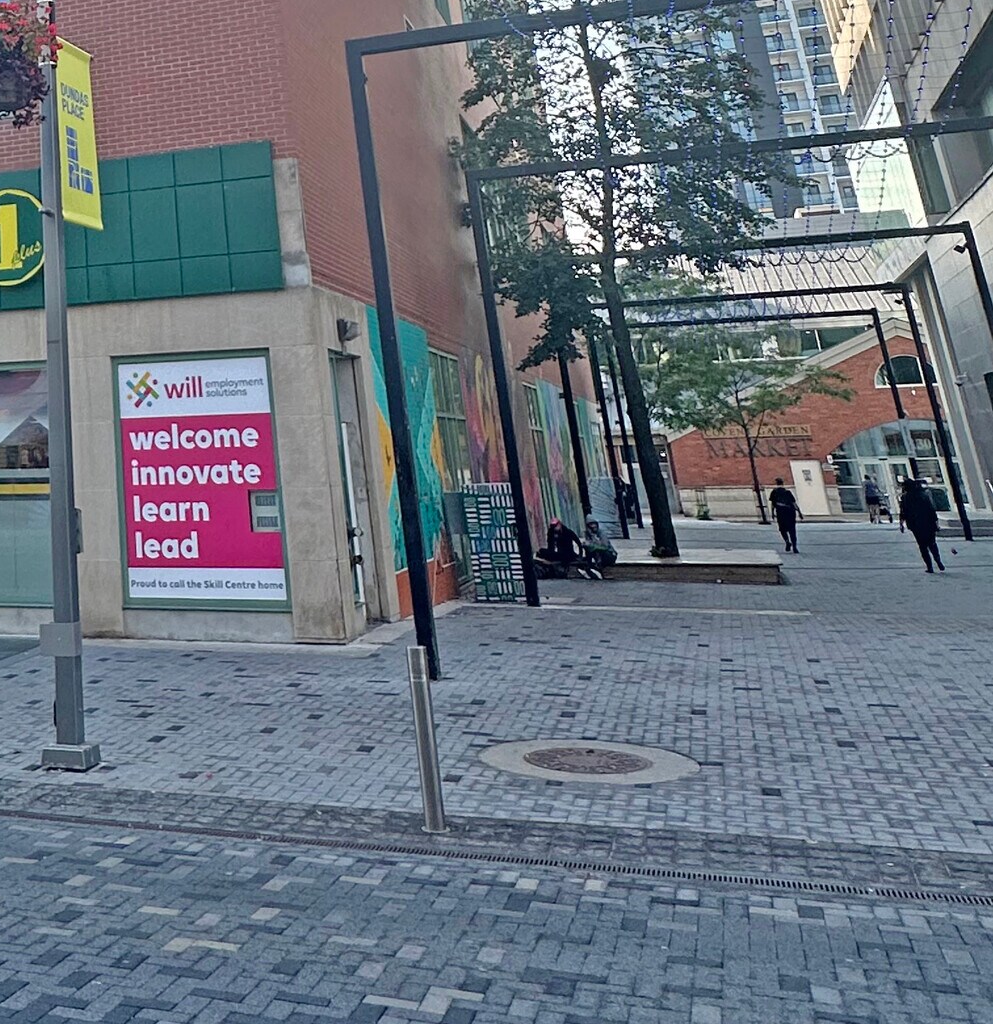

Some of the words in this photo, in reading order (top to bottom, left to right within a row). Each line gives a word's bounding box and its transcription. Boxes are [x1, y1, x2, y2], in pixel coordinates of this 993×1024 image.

[60, 81, 89, 107] DUNDAS
[61, 97, 85, 120] PLACE
[163, 376, 204, 399] will
[205, 377, 265, 389] employment
[205, 388, 248, 398] solutions
[129, 423, 260, 451] welcome
[757, 425, 809, 436] GARDEN
[705, 437, 813, 458] MARKET
[131, 459, 262, 487] innovate
[133, 495, 211, 523] learn
[134, 530, 200, 560] lead
[130, 579, 157, 589] Proud
[158, 579, 169, 589] to
[169, 579, 186, 589] call
[186, 579, 203, 590] the
[203, 579, 224, 590] Skill
[225, 579, 257, 590] Centre
[257, 580, 284, 591] home
